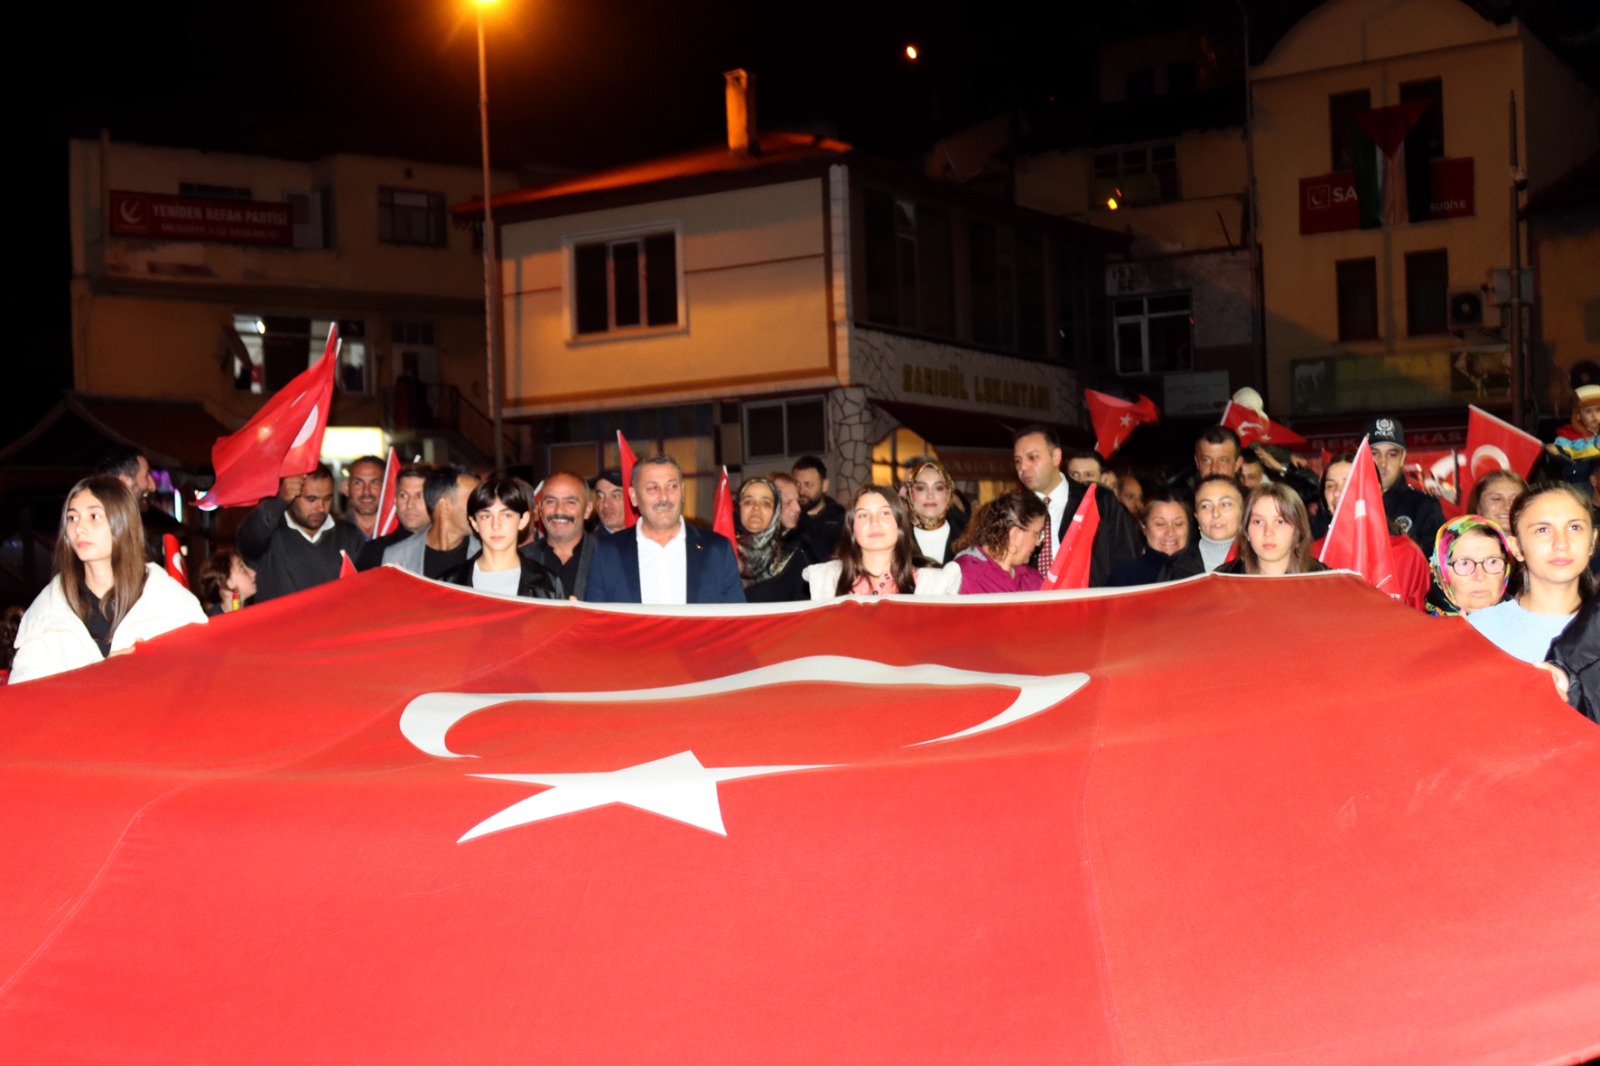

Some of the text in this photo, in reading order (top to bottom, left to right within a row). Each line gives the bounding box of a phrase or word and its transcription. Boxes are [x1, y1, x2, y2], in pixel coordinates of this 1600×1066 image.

[1332, 186, 1358, 203] SA
[152, 202, 203, 220] YENİDEN
[205, 206, 242, 222] REFAH
[1429, 199, 1467, 212] SUDİYE
[1312, 431, 1462, 450] BEK KAS
